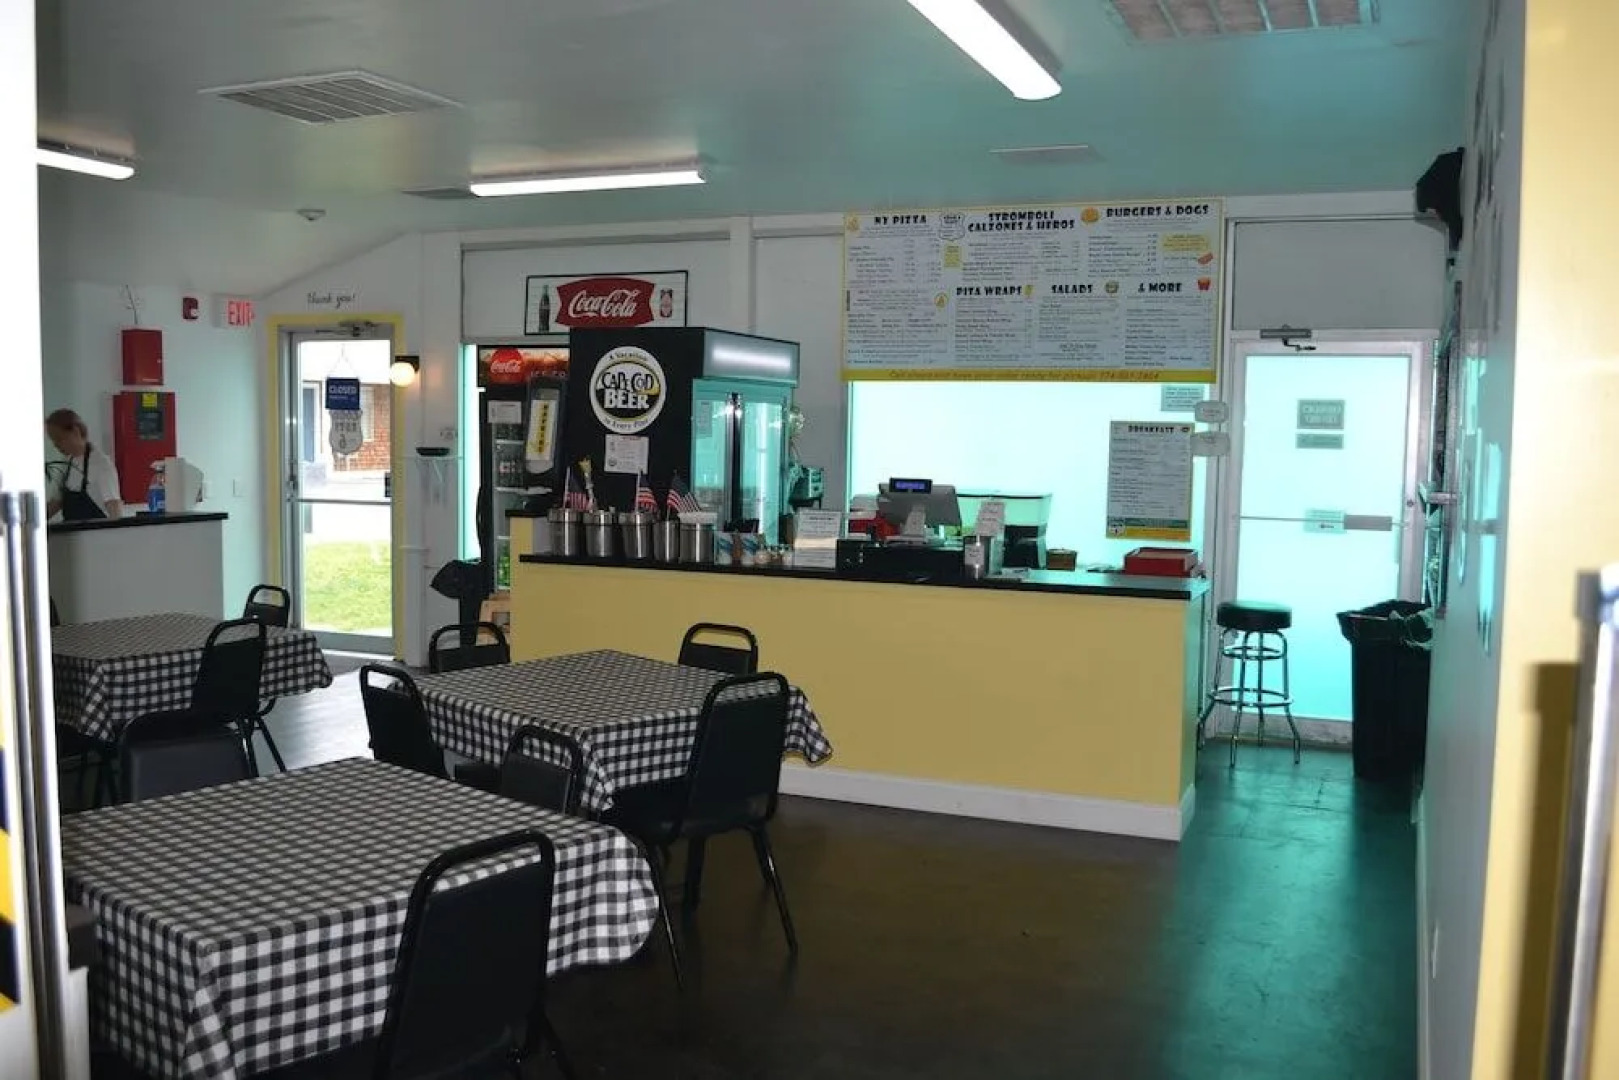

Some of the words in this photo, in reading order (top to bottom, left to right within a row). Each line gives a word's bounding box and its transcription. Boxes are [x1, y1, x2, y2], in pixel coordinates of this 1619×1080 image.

[988, 210, 1054, 221] STROMBOLI
[1106, 206, 1162, 218] BURGERS
[1176, 204, 1209, 216] DOGS
[893, 215, 927, 225] PIZZA
[968, 222, 1023, 232] CALZONES
[1037, 219, 1076, 230] HEROS
[956, 286, 981, 296] PITA
[983, 284, 1023, 296] WRAPS
[1051, 284, 1093, 294] SALADS
[1149, 282, 1182, 293] MORE
[568, 289, 641, 318] Coca-Cola
[228, 301, 250, 325] EXIT
[604, 388, 649, 409] BEER
